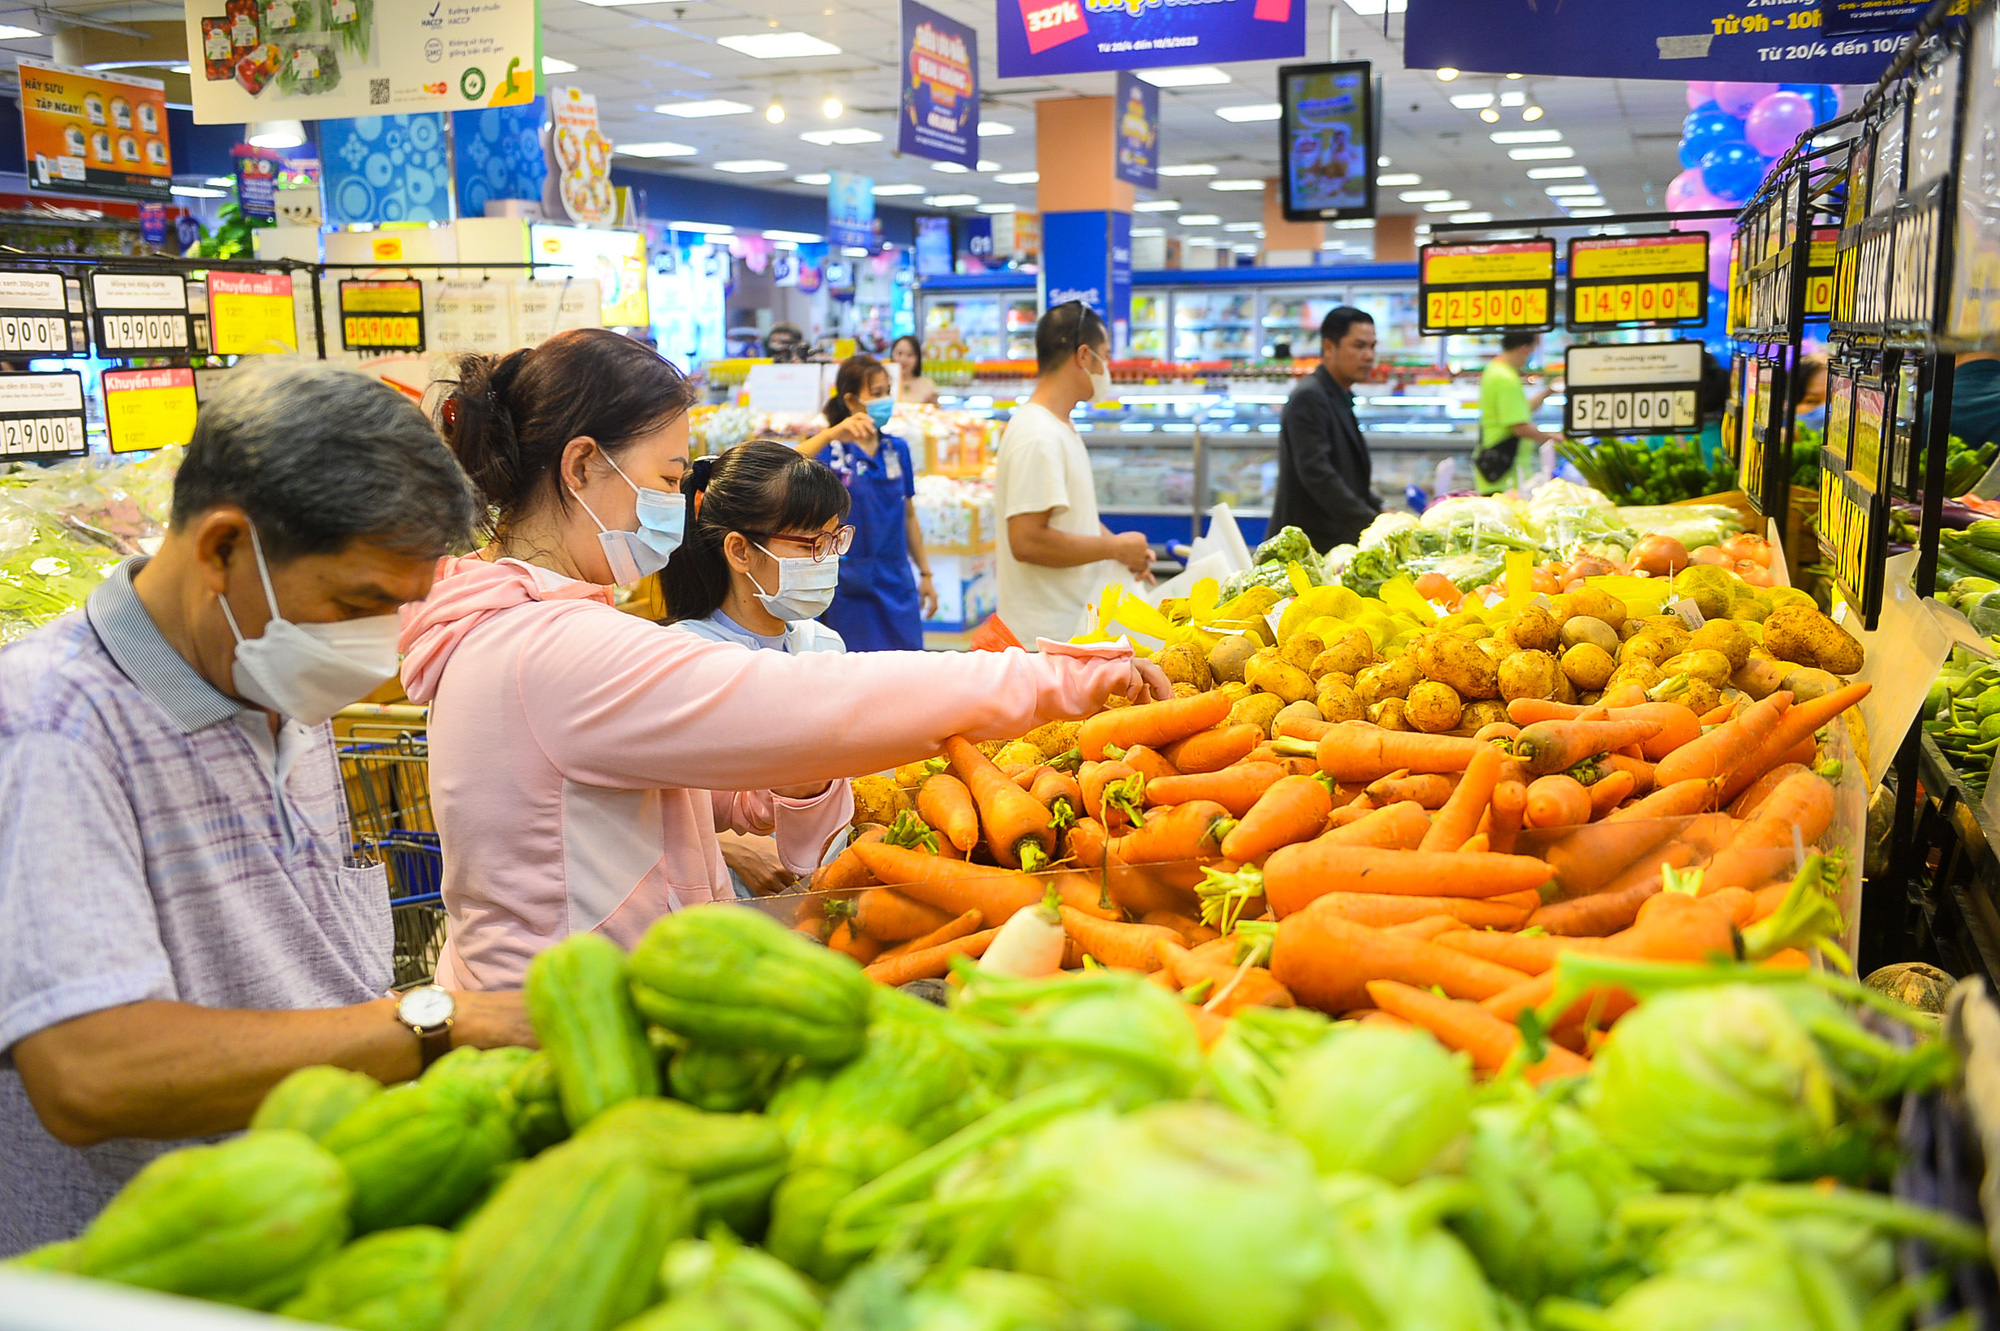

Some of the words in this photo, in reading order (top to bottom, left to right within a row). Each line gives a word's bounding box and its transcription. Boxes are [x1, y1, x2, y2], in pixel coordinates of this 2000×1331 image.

[1026, 8, 1079, 32] 327k
[1711, 13, 1741, 35] Từ
[1741, 13, 1770, 33] 9h
[1757, 46, 1783, 62] Từ
[1785, 41, 1828, 60] 20/4
[1831, 38, 1868, 56] đến
[25, 78, 42, 90] HÃY
[44, 82, 64, 95] SƯU
[35, 98, 53, 112] TẬP
[54, 101, 82, 115] NGAY!
[212, 278, 252, 295] Khuyến
[253, 278, 273, 294] mãi
[1583, 288, 1674, 314] 14.900
[109, 321, 171, 340] 19.900
[106, 372, 150, 391] Khuyến
[151, 369, 172, 387] mãi
